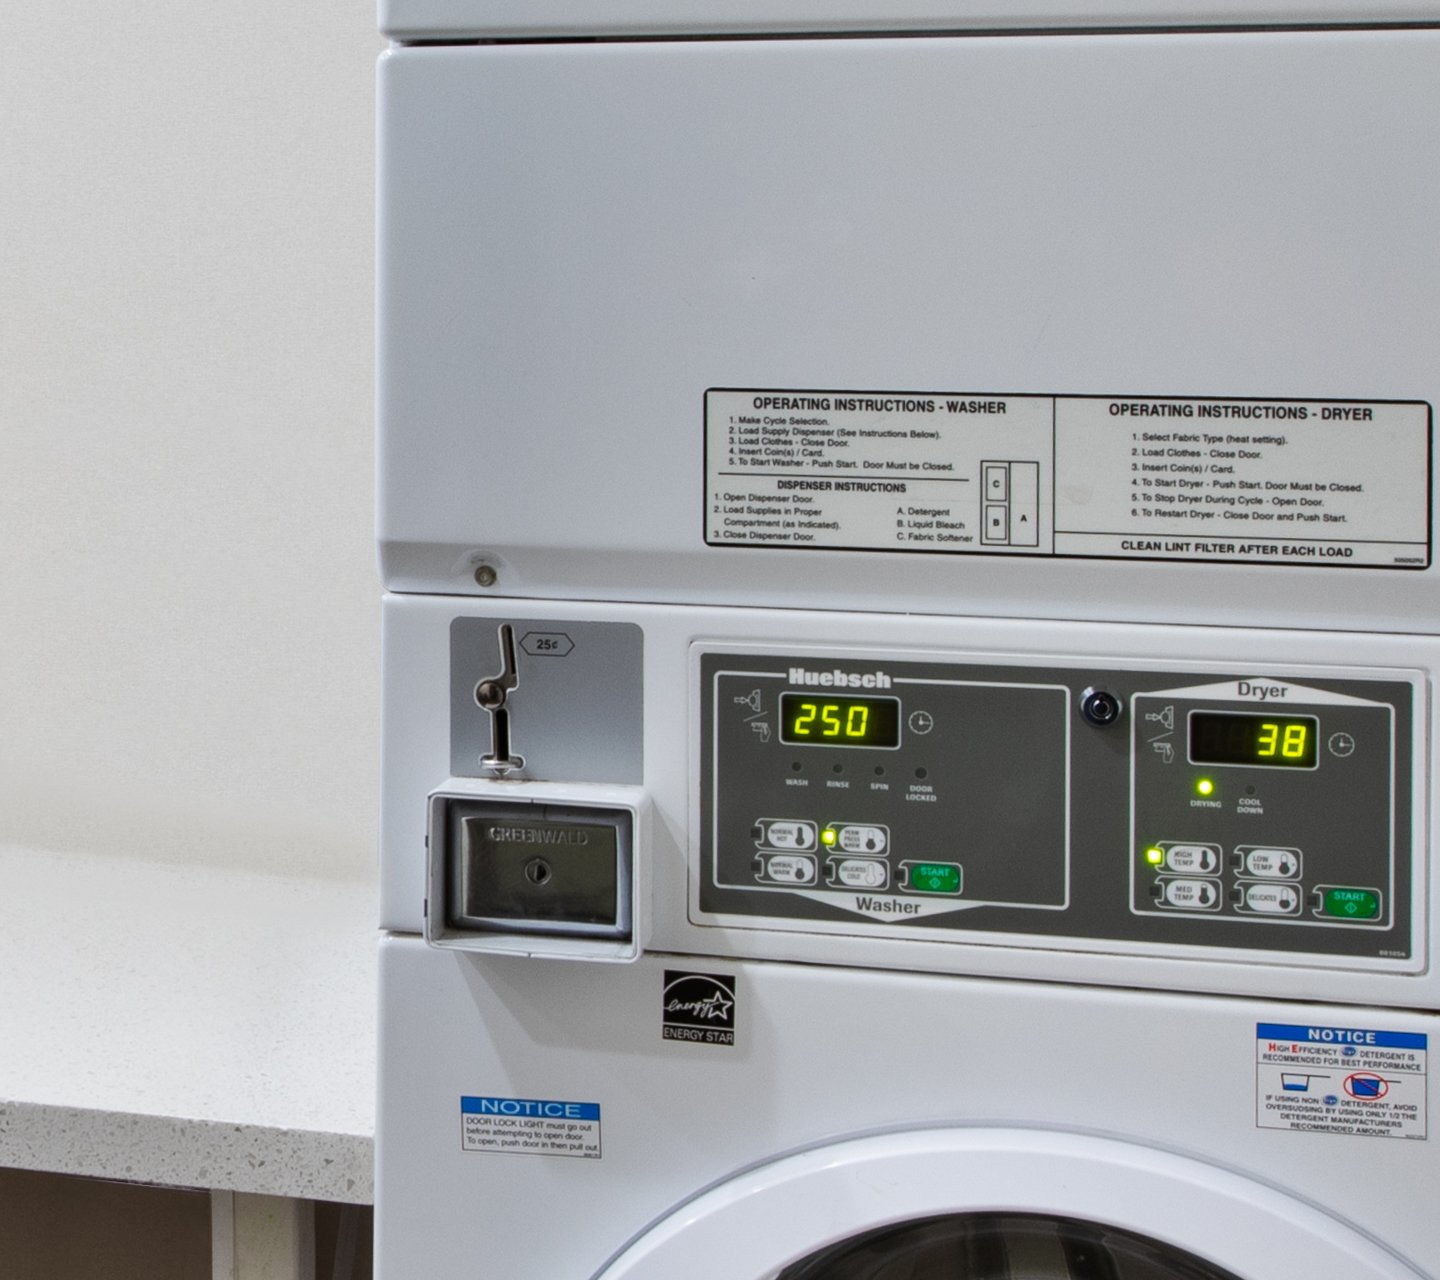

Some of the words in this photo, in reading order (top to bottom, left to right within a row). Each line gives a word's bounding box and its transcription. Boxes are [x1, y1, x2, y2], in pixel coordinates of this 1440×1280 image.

[753, 397, 830, 410] OPERATING
[834, 398, 935, 412] INSTRUCTIONS
[946, 400, 1006, 413] WASHER
[1109, 403, 1193, 417] OPERATING
[1198, 405, 1308, 419] INSTRUCTIONS
[1321, 407, 1372, 421] DRYER
[777, 480, 832, 490] DISPENSER
[834, 481, 906, 492] INSTRUCTIONS
[992, 479, 1000, 488] C
[993, 518, 1000, 527] B
[1020, 515, 1027, 523] A
[1121, 540, 1161, 550] CLEAN
[1165, 542, 1191, 551] LINT
[1194, 542, 1235, 553] FILTER
[1238, 544, 1278, 554] AFTER
[1282, 545, 1315, 556] EACH
[1319, 547, 1352, 557] LOAD
[789, 668, 891, 689] Huebsch
[1237, 682, 1288, 700] Dryer
[794, 704, 869, 737] 250
[1258, 723, 1307, 758] 38
[786, 778, 808, 786] WASH
[870, 783, 889, 791] SPIN
[910, 785, 933, 793] DOOR
[906, 793, 937, 802] LOCKED
[1238, 798, 1262, 806] COOL
[1190, 800, 1222, 808] DRYING
[1237, 806, 1263, 814] DOWN
[489, 827, 589, 846] GREENWALD
[1333, 891, 1365, 902] START
[855, 897, 921, 914] Washer
[664, 1027, 704, 1040] ENERGY
[706, 1031, 733, 1043] STAR
[1308, 1029, 1376, 1044] NOTICE
[1360, 1050, 1405, 1060] DETERGENT
[1263, 1053, 1321, 1064] RECOMMENDED
[1323, 1057, 1339, 1065] FOR
[1341, 1058, 1360, 1066] BEST
[1363, 1060, 1421, 1071] PERFORMANCE
[481, 1099, 581, 1117] NOTICE
[466, 1117, 491, 1125] DOOR
[519, 1120, 544, 1128] LIGHT
